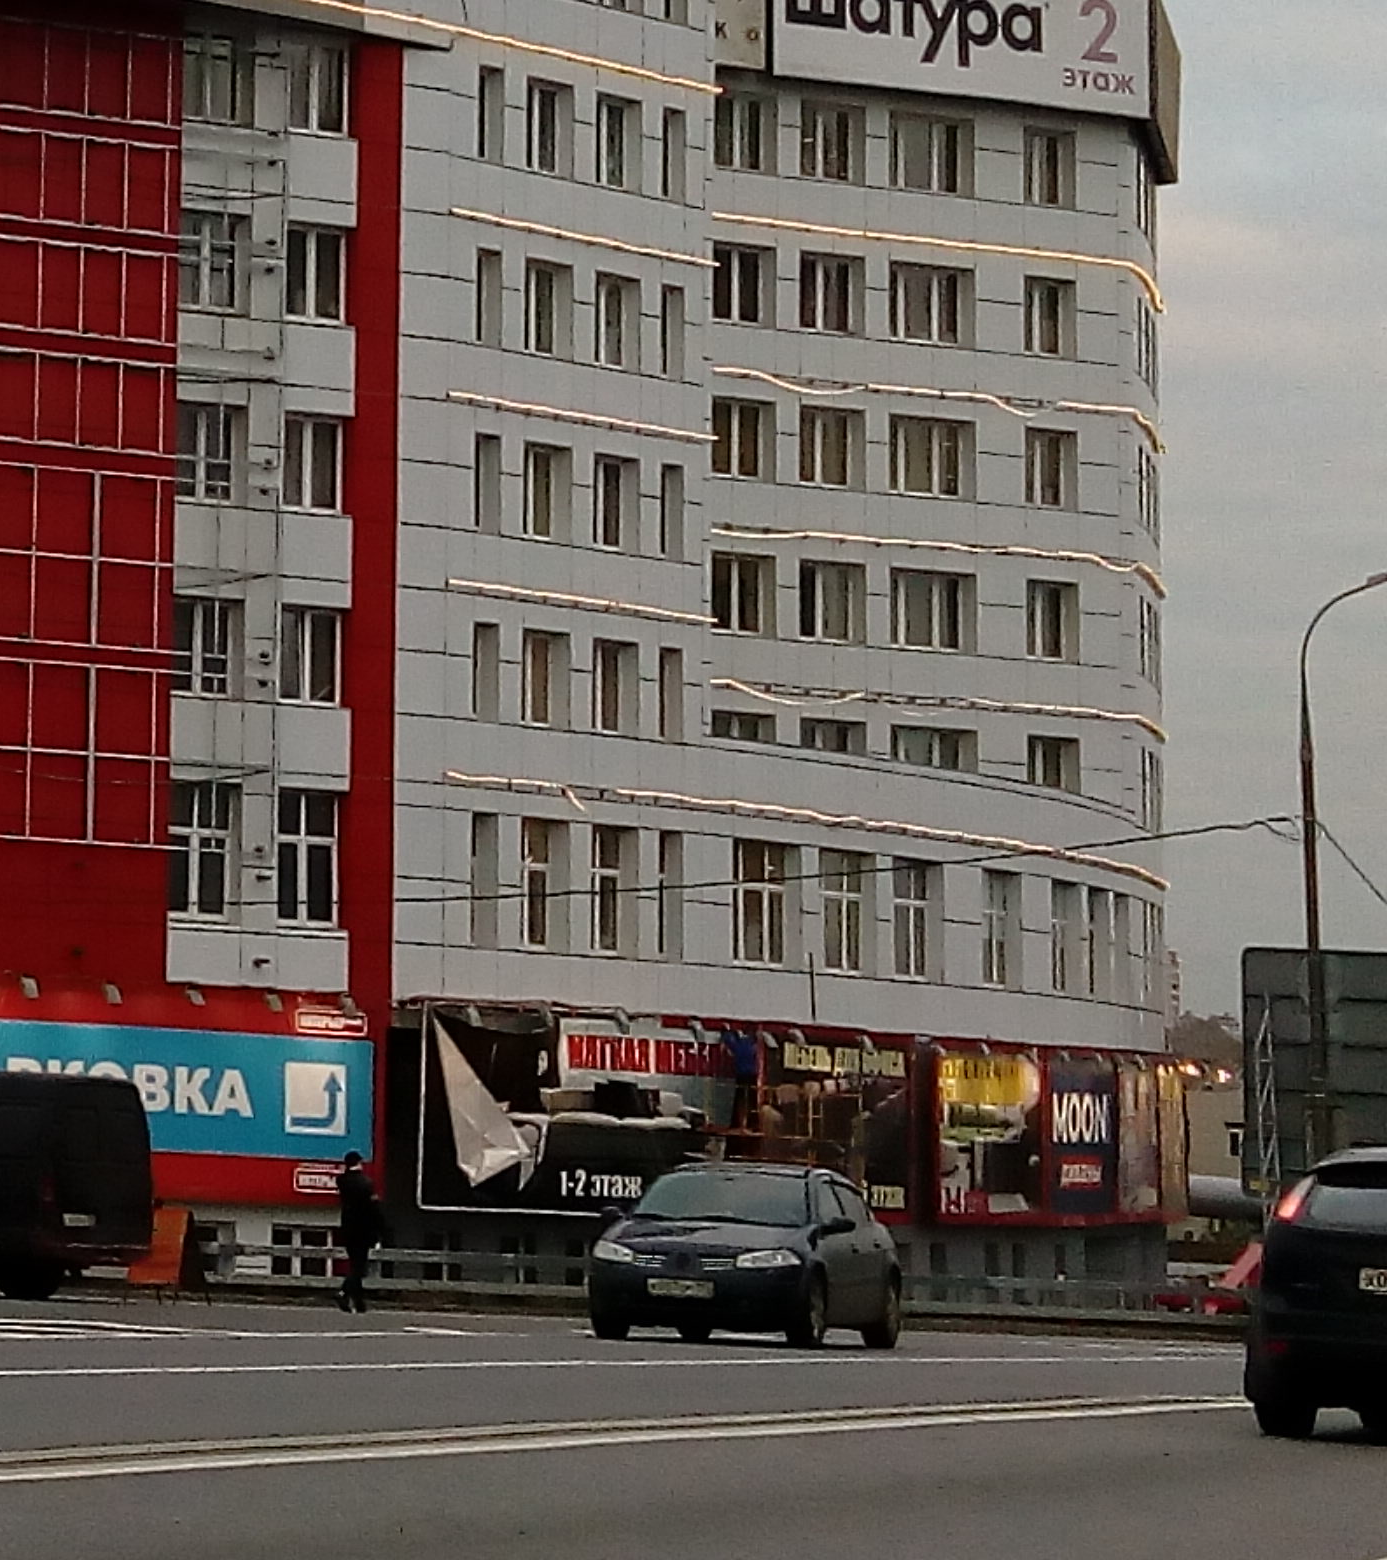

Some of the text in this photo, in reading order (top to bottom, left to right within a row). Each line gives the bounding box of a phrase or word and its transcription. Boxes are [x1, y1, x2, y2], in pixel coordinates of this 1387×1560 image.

[1062, 68, 1135, 95] этаж
[1052, 1091, 1109, 1144] MOON
[560, 1169, 642, 1197] 1-2 этаж
